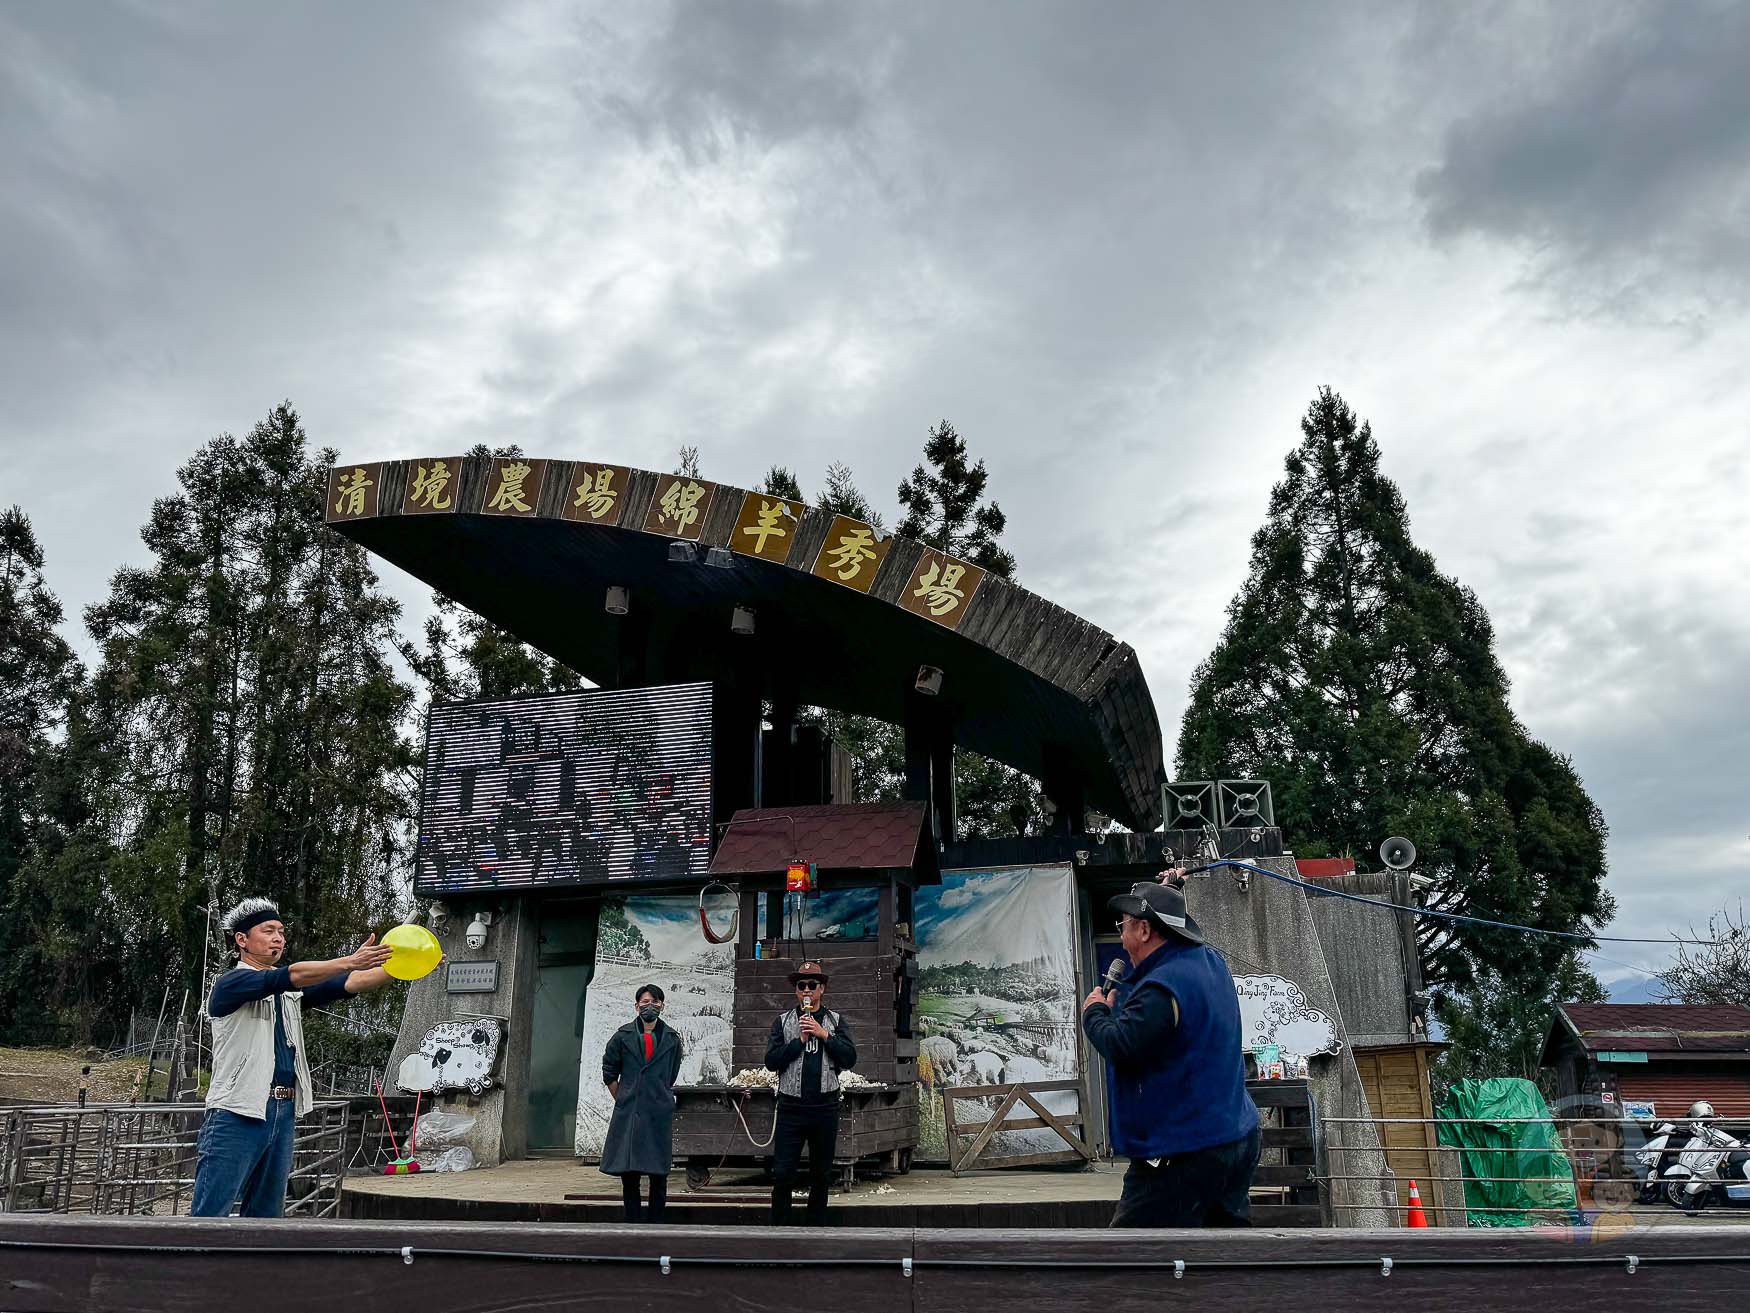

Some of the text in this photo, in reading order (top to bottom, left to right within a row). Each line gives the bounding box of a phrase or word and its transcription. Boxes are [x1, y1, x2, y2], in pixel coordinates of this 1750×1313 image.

[335, 461, 965, 616] 清境農場綿羊秀場
